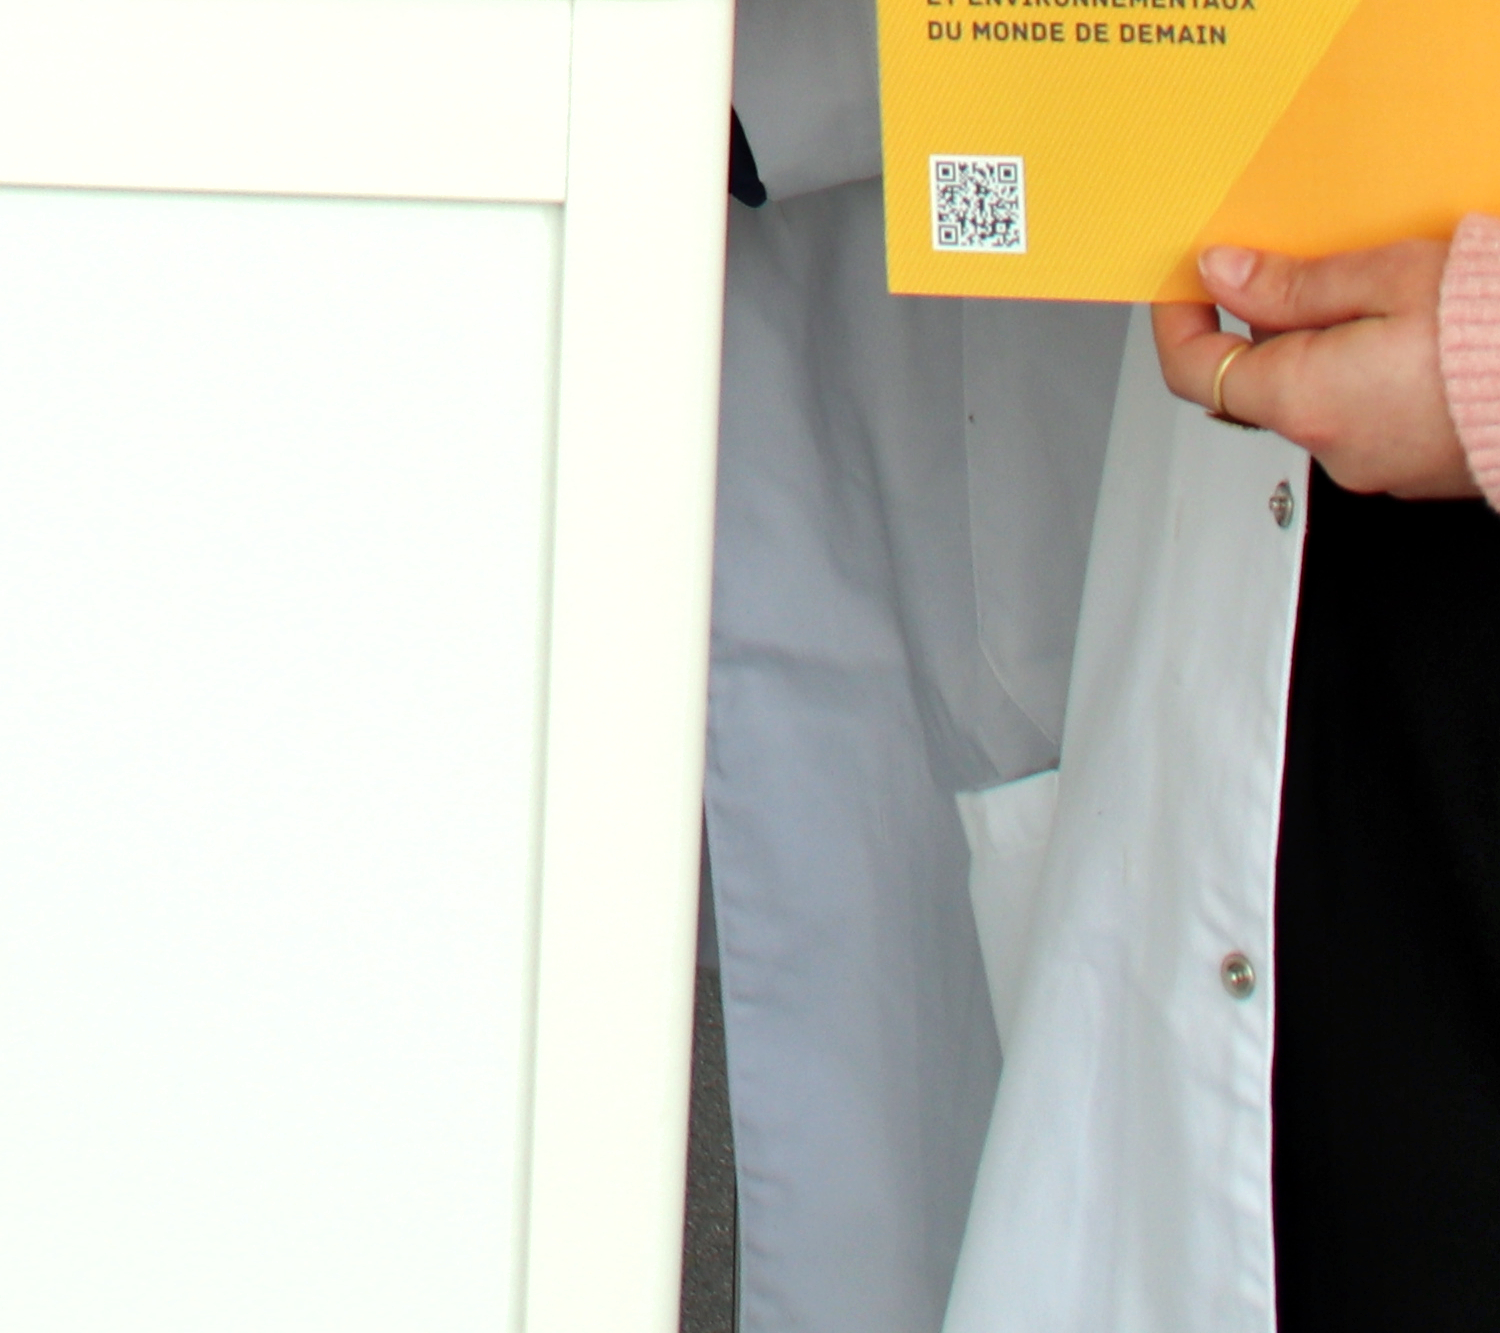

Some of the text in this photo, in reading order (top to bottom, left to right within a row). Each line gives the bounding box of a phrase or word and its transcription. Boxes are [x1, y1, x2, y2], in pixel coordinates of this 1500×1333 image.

[927, 21, 1227, 45] DU MONDE DE DEMAIN
